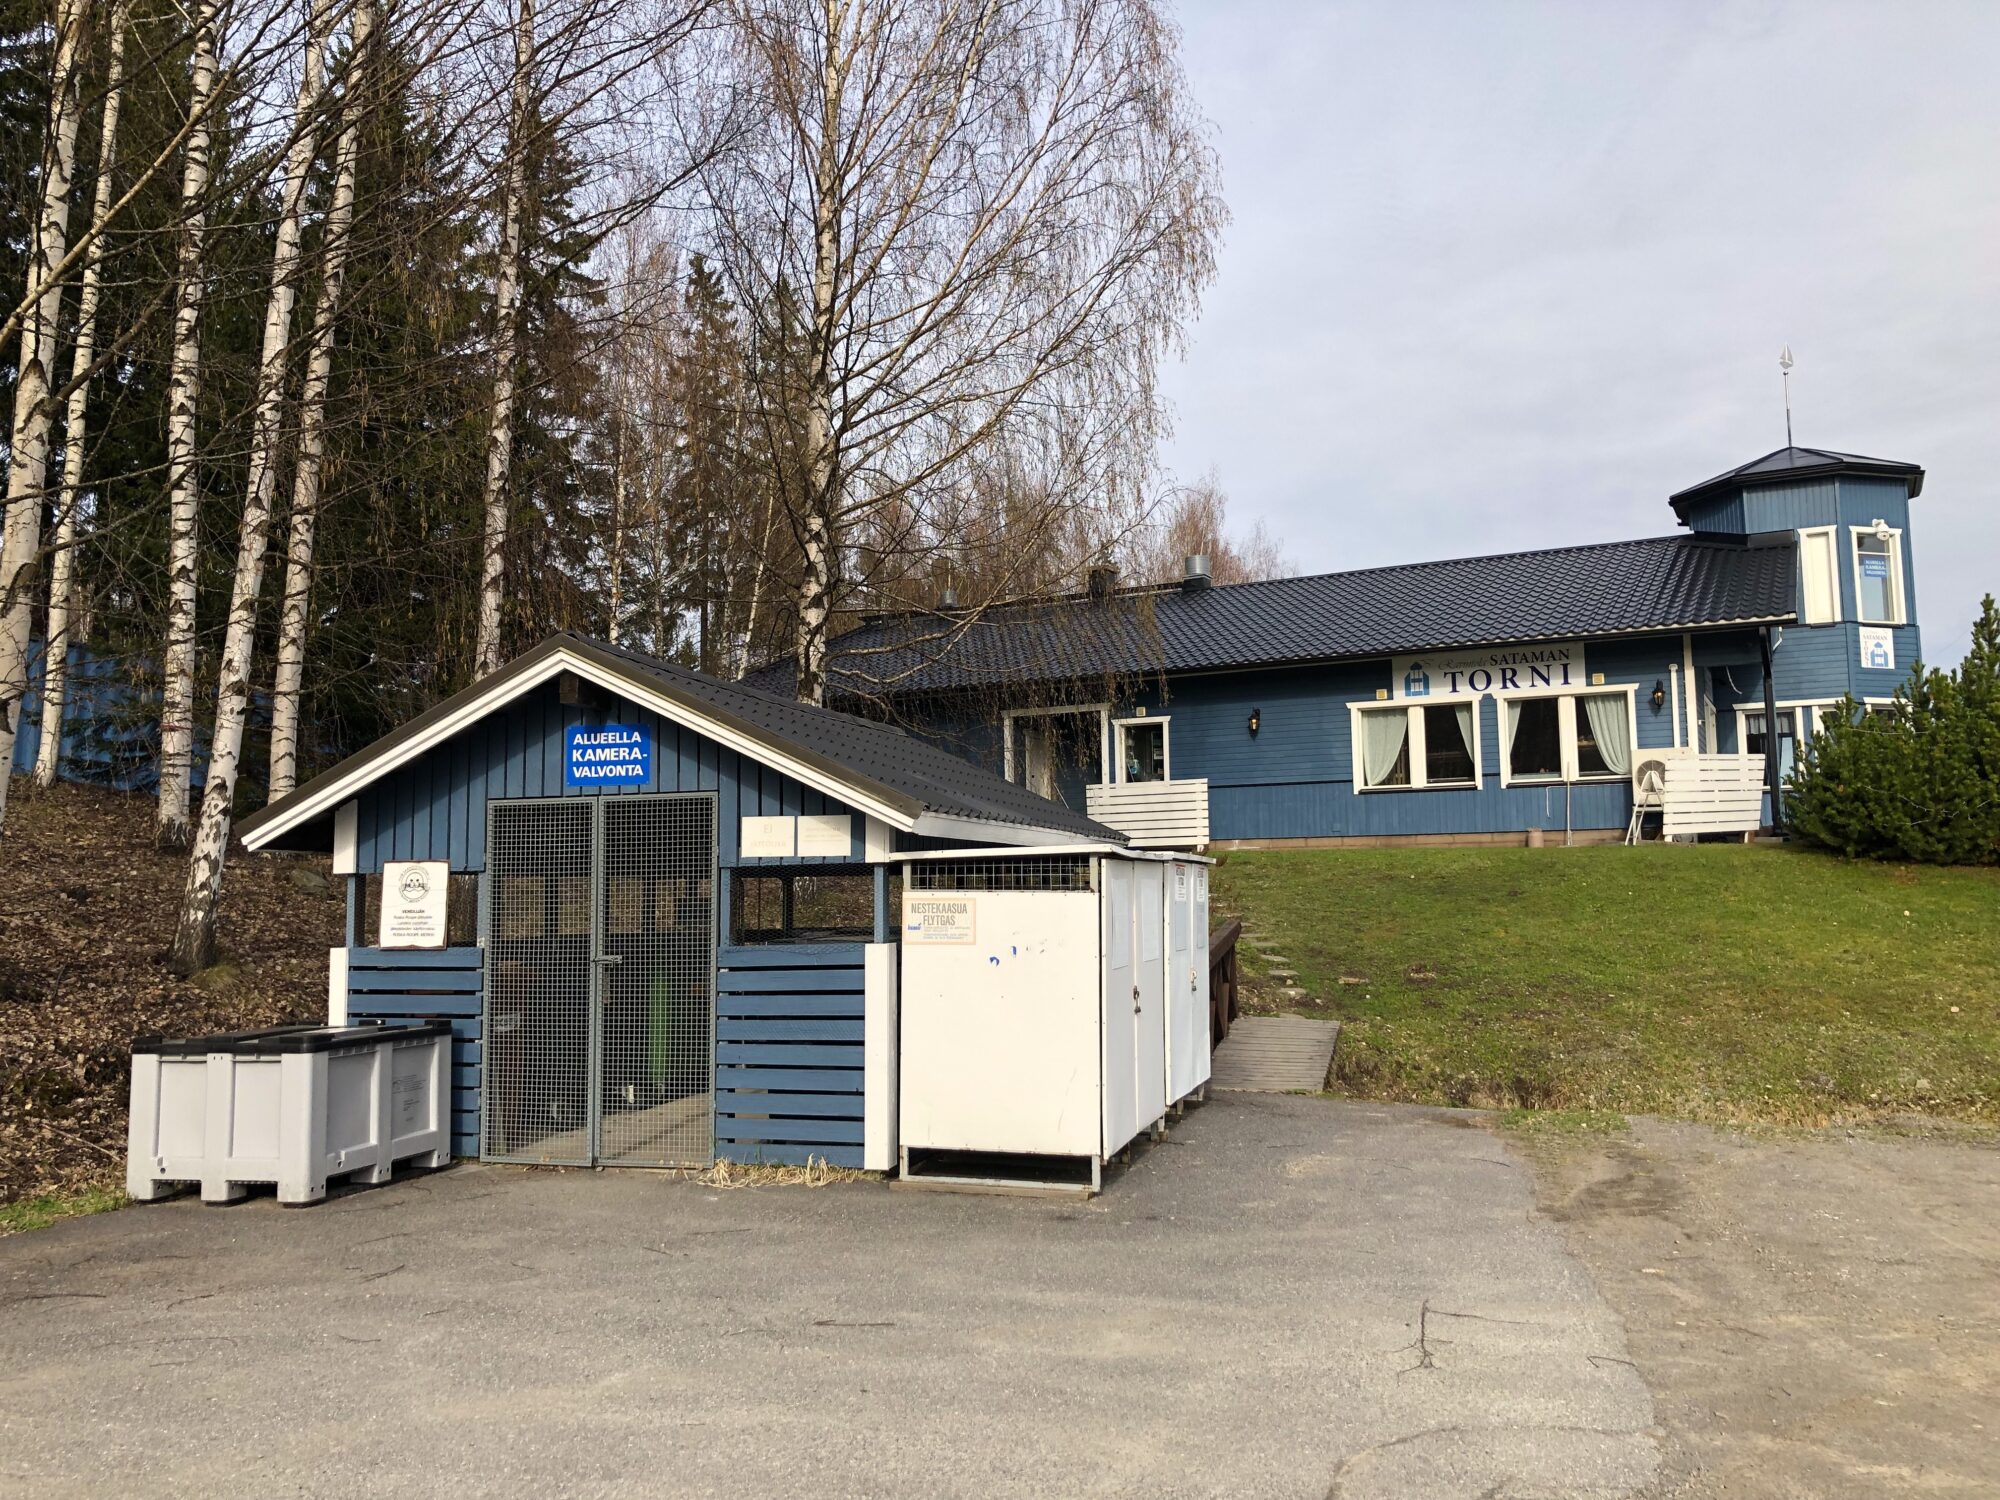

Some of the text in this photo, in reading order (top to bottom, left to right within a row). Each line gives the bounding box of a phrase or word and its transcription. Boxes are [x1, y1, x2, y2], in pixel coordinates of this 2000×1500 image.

[1489, 648, 1570, 667] SATAMAN
[1443, 662, 1572, 694] TORNI
[573, 731, 642, 745] ALUEELLA
[572, 747, 648, 762] KAMERA-
[572, 764, 644, 778] VALVONTA
[911, 902, 968, 914] NESTEKAASUA
[923, 914, 956, 926] FLYTGAS
